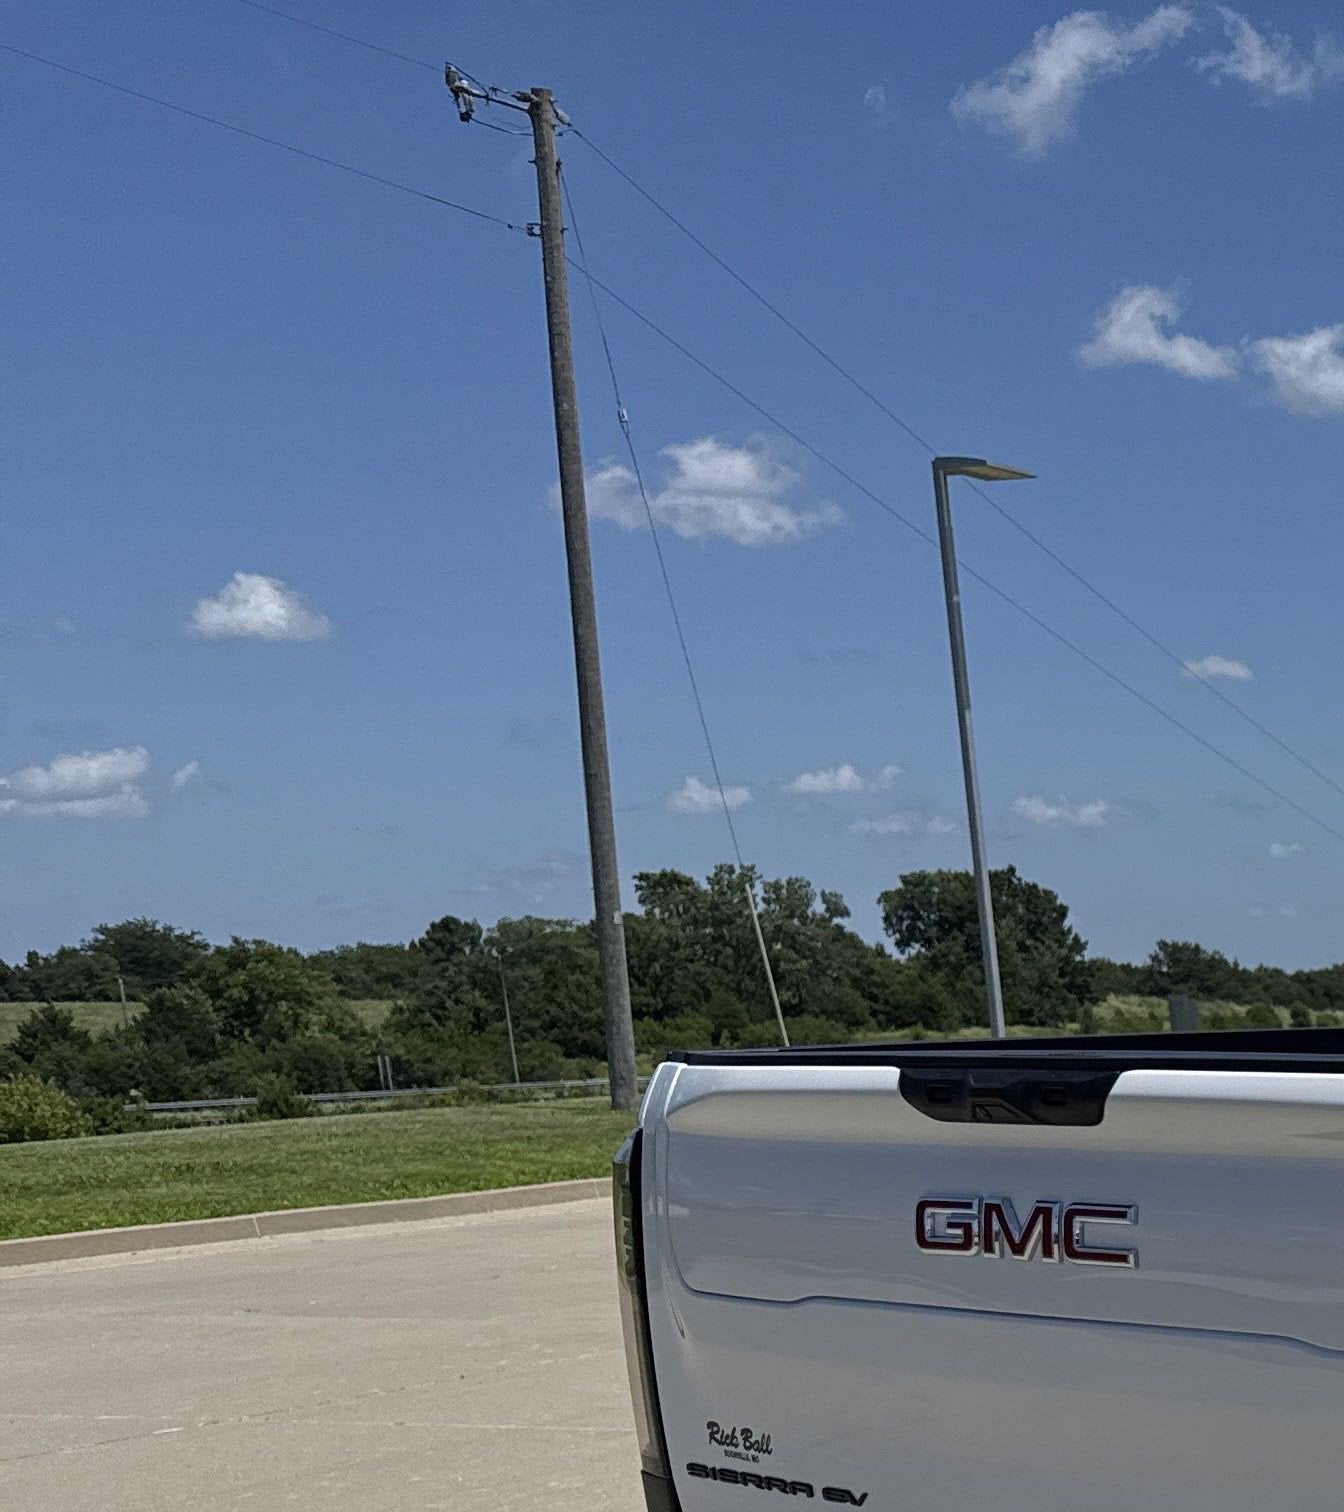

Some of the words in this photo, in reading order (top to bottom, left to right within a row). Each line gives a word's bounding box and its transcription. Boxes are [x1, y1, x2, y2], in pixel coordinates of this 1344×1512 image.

[914, 1193, 1138, 1268] GMC
[706, 1420, 741, 1449] Rick
[740, 1427, 774, 1456] Ball
[686, 1462, 815, 1499] SIERRA
[821, 1486, 869, 1507] EV
